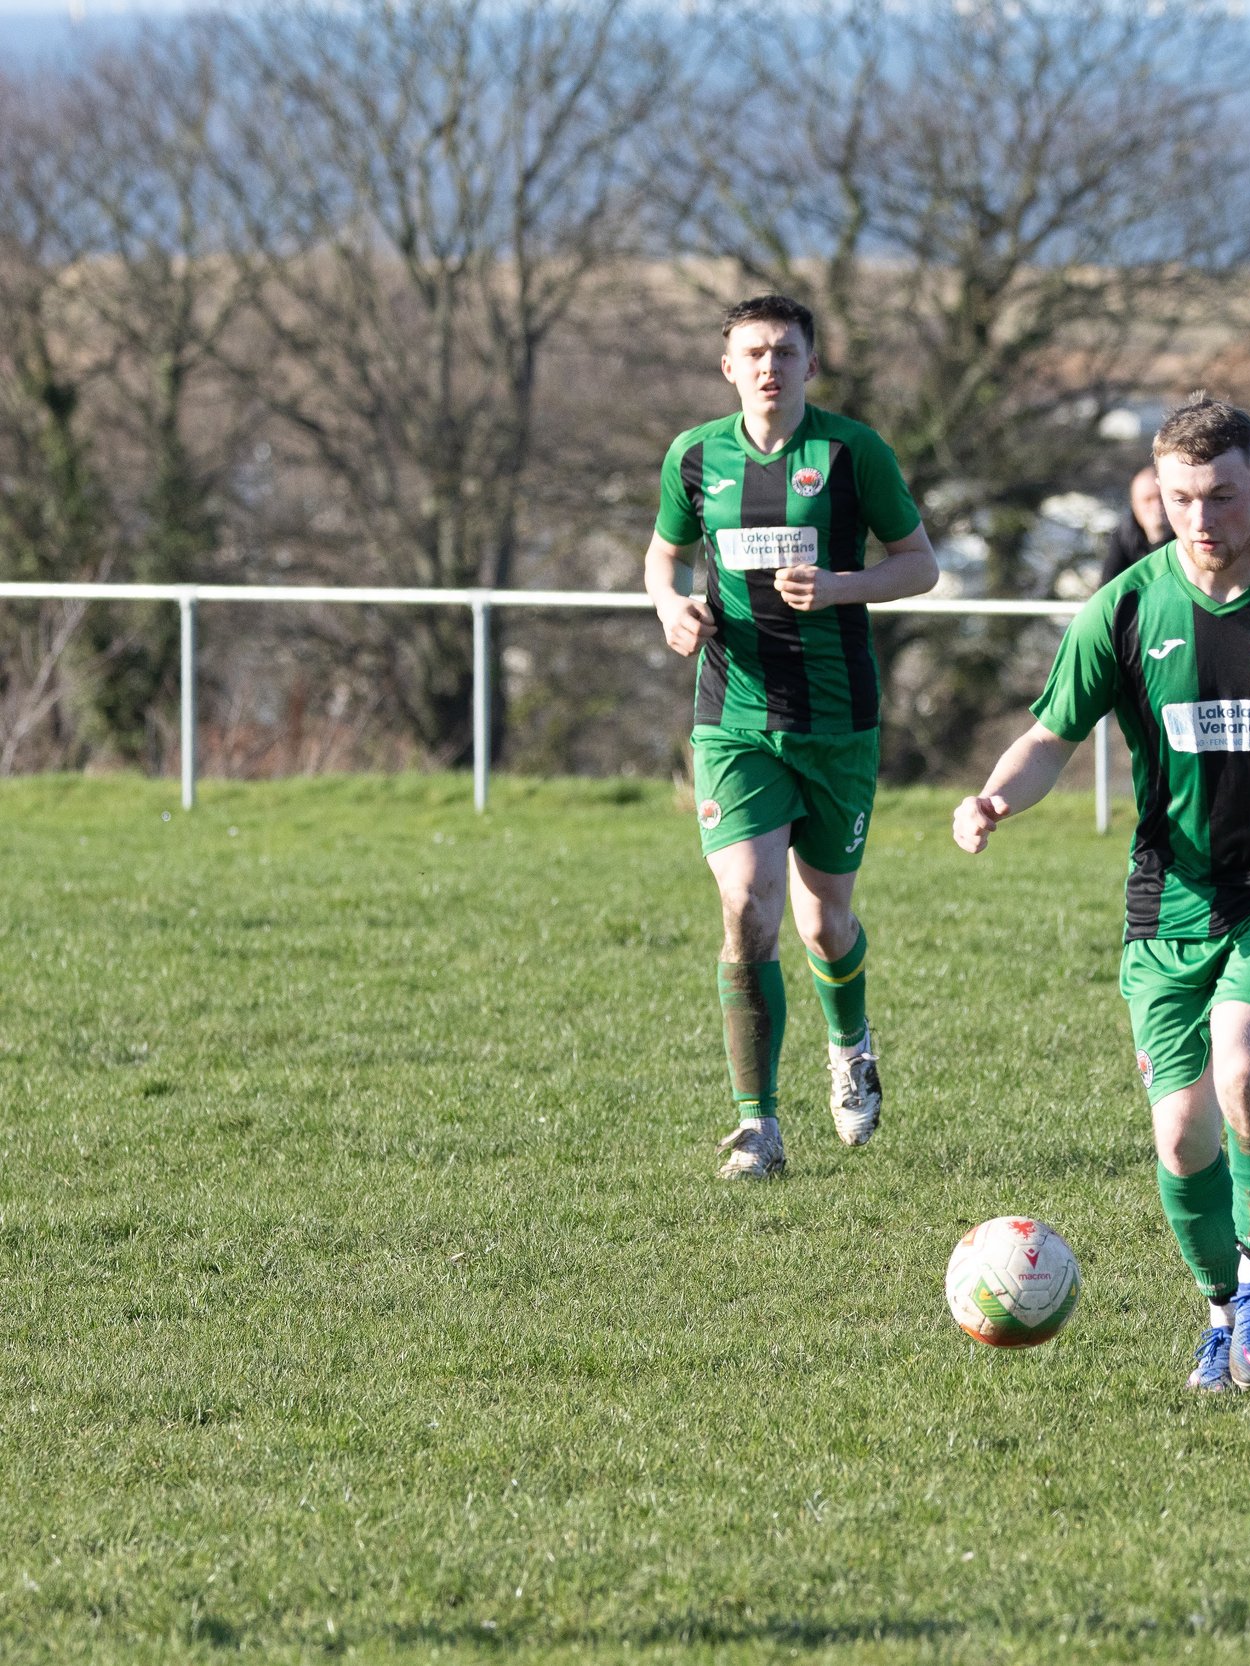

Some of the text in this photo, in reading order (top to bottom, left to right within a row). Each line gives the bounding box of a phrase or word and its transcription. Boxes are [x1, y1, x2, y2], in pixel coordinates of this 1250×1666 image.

[1209, 738, 1242, 746] FENCNG
[854, 812, 865, 836] 6
[1018, 1273, 1051, 1281] macron
